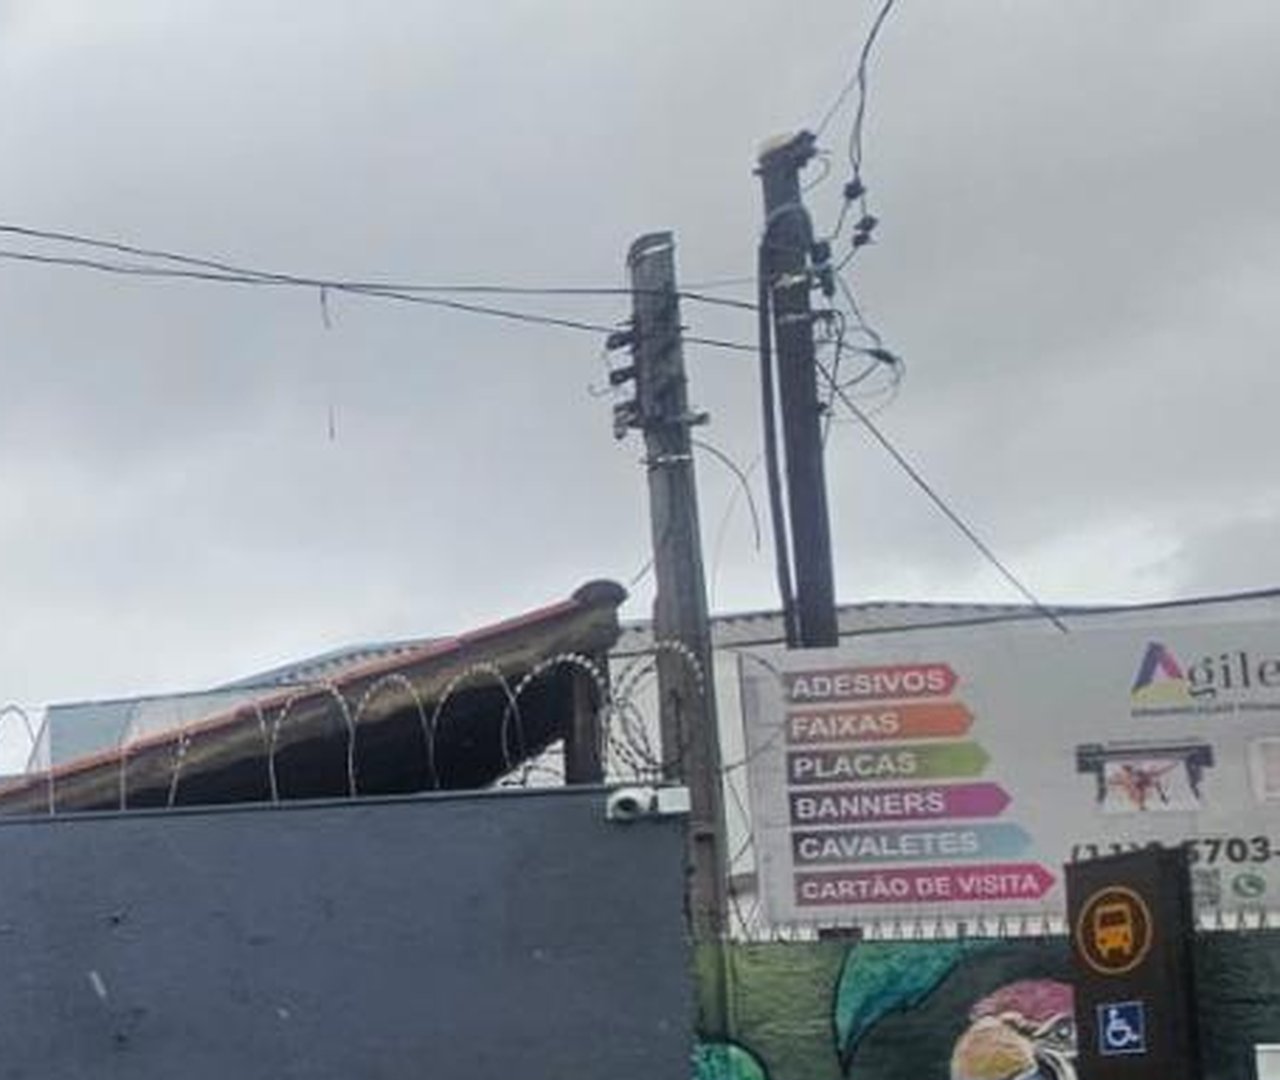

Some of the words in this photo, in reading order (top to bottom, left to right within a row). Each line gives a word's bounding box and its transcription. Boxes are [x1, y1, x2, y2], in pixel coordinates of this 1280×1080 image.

[792, 669, 946, 698] ADESIVOS
[792, 712, 900, 738] FAIXAS
[794, 751, 918, 778] PLACAS
[795, 791, 944, 820] BANNERS
[798, 831, 978, 860] CAVALETES
[802, 874, 910, 900] CARTÃO
[915, 877, 951, 896] DE
[957, 873, 1040, 895] VISITA
